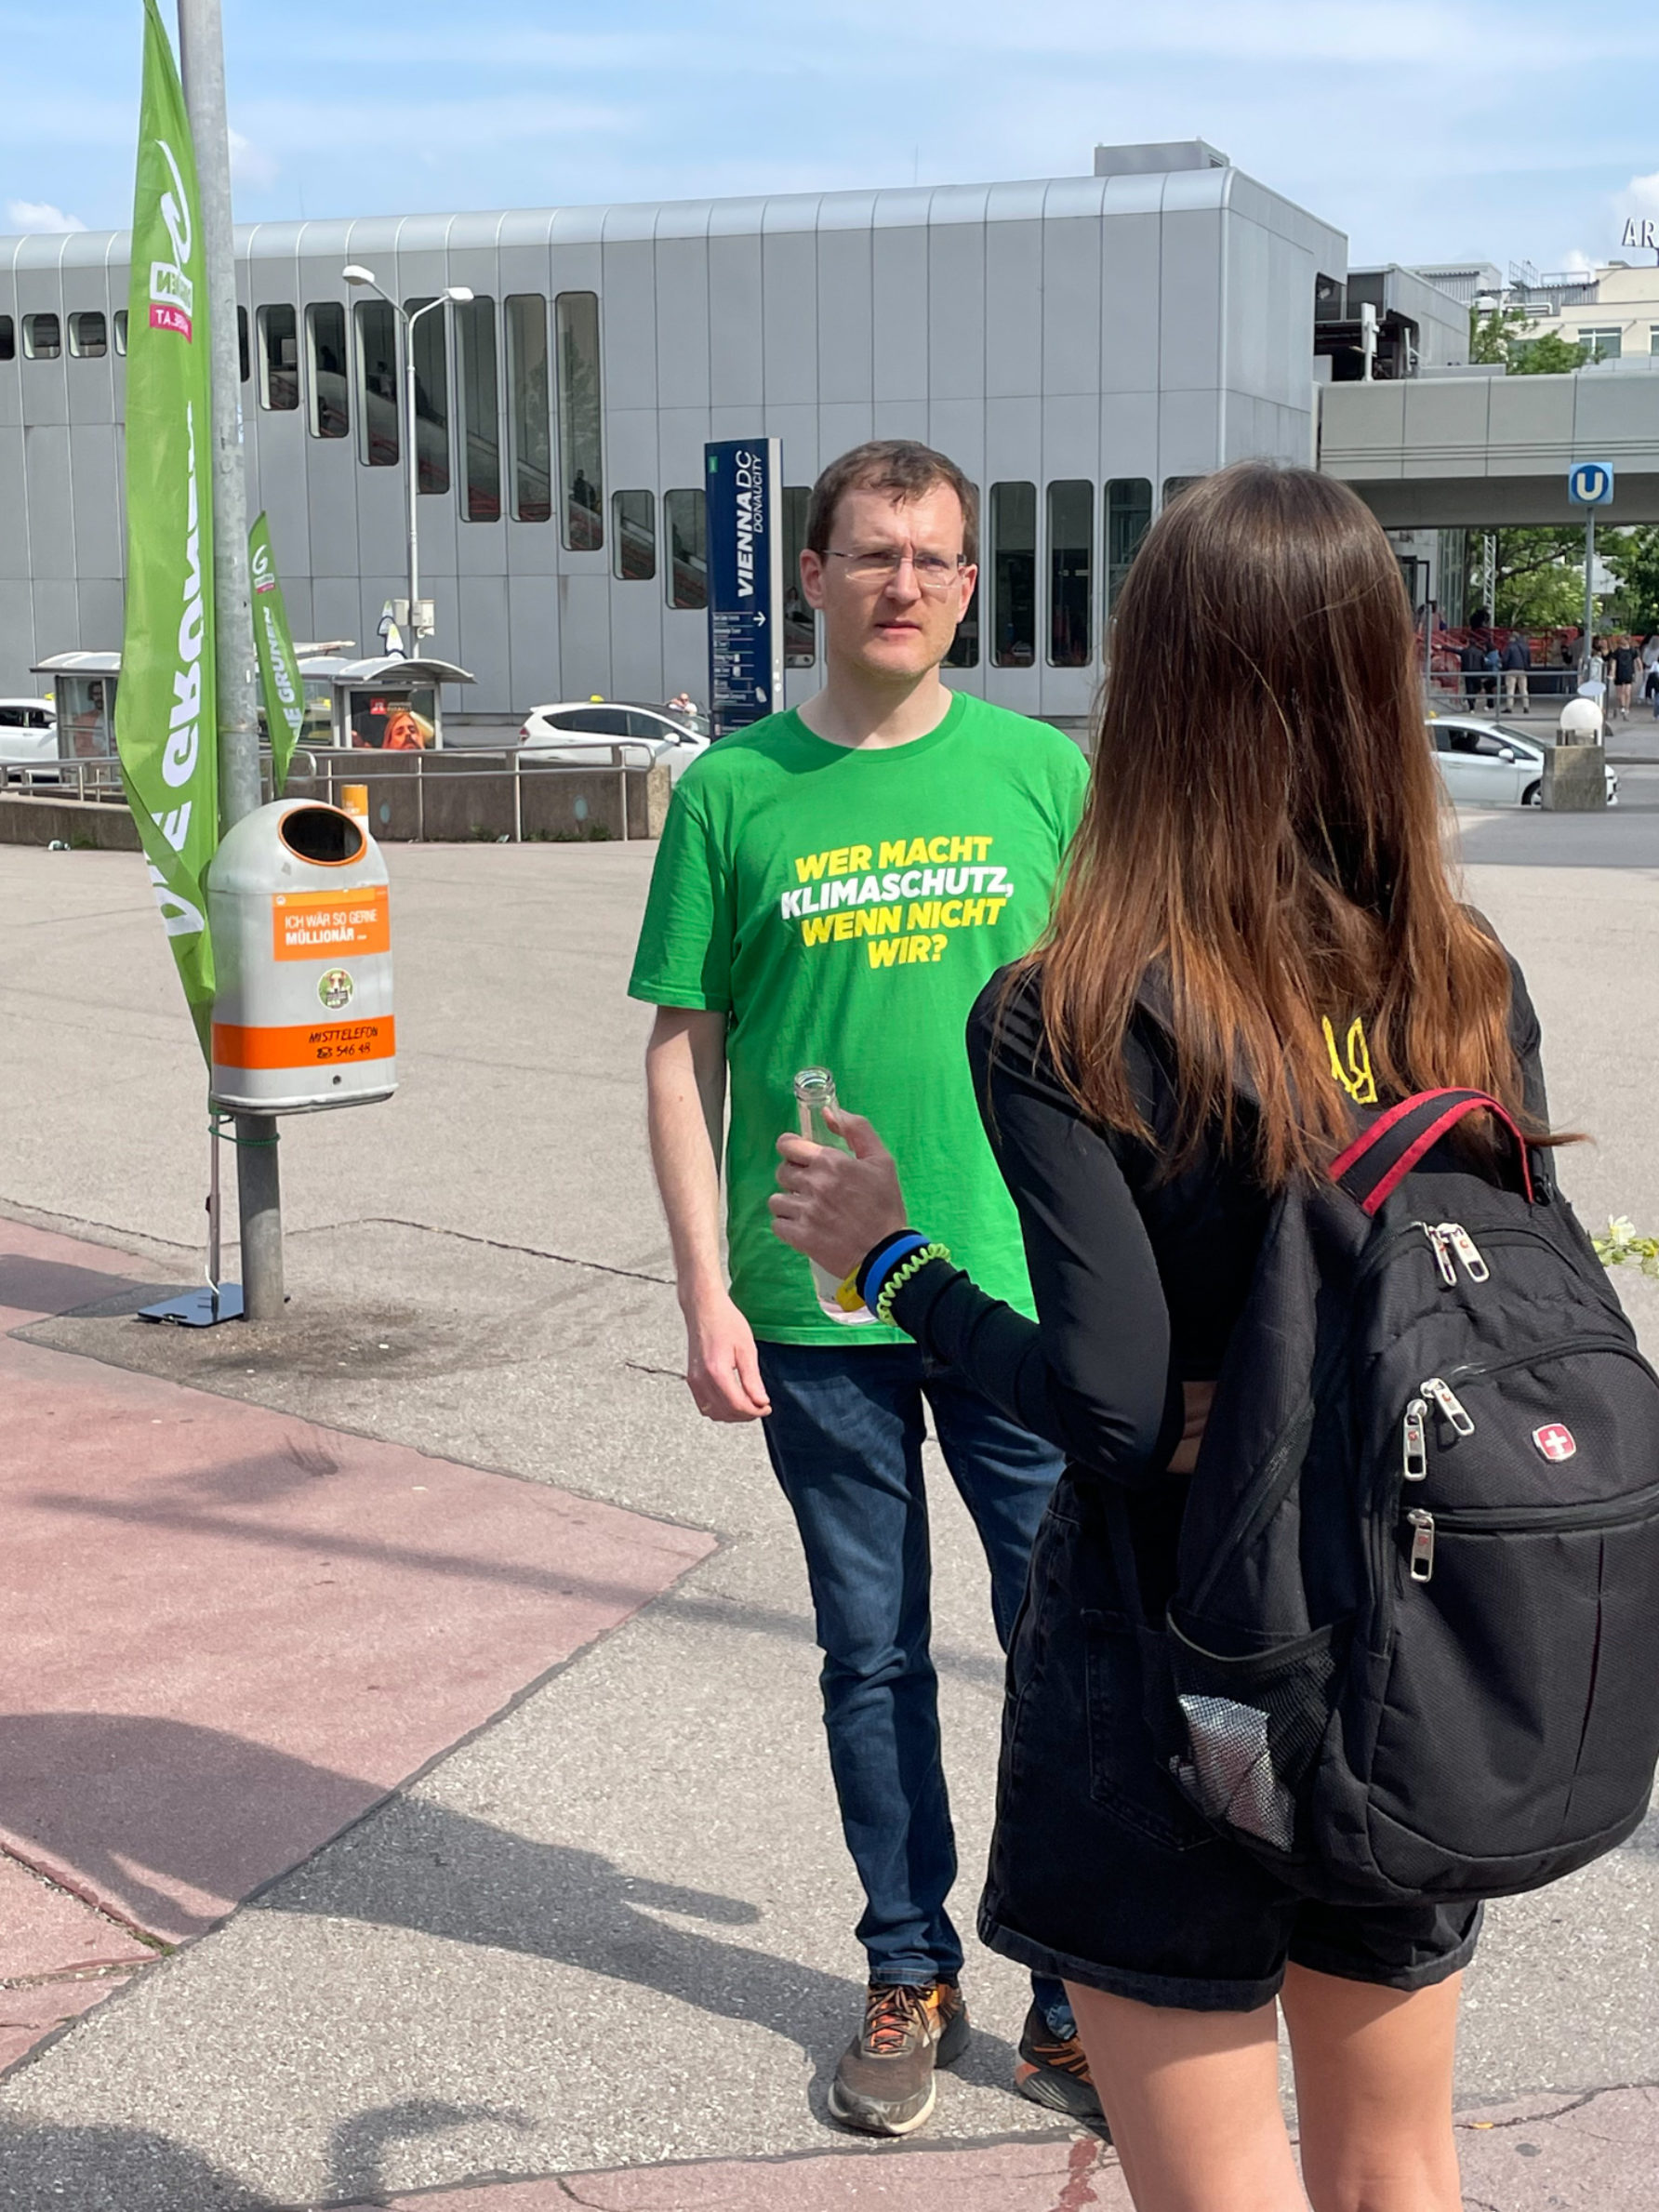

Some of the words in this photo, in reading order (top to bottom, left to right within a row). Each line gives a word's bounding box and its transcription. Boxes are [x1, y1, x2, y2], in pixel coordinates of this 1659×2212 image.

[752, 454, 763, 534] DONAUCITY
[1576, 471, 1604, 501] U
[795, 844, 872, 883] WER
[878, 836, 993, 869] MACHT
[780, 867, 1015, 920] KLIMASCHUTZ,
[285, 915, 304, 929] ICH
[306, 911, 331, 928] WÄR
[333, 911, 347, 926] SO
[349, 908, 378, 924] GERNE
[801, 905, 902, 947] WENN
[907, 897, 1007, 931] NICHT
[285, 926, 354, 946] MÜLLIONÄR
[867, 934, 948, 969] WIR?
[309, 1026, 378, 1043] MISTTELEFON
[337, 1043, 355, 1057] 546
[358, 1041, 371, 1053] 48
